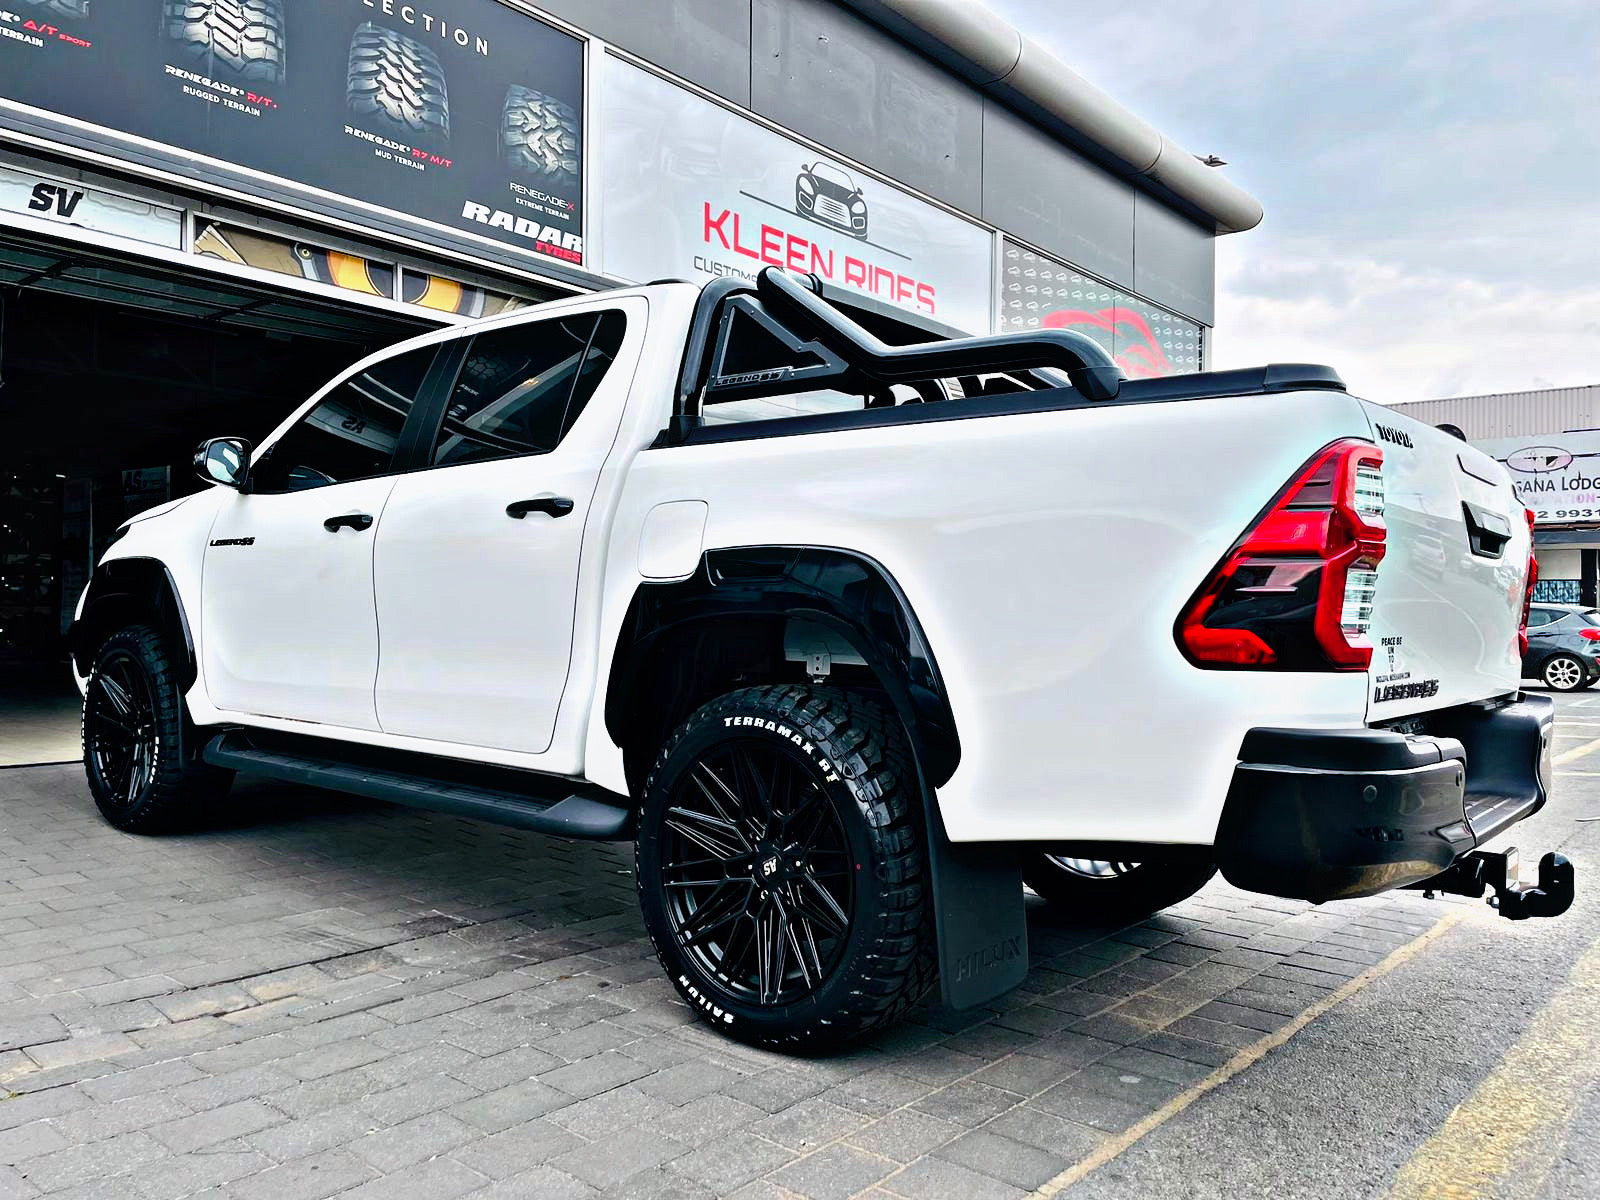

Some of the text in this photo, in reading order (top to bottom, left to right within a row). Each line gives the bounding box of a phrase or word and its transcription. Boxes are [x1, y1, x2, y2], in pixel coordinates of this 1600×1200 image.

[23, 19, 58, 36] A/T
[59, 33, 92, 48] SPORT
[183, 85, 261, 117] RUGGED TERRAIN
[375, 148, 425, 171] MUD TERRAIN
[429, 155, 453, 168] M/T
[28, 182, 84, 217] SV
[515, 197, 570, 221] EXTREME TERRAIN
[461, 200, 583, 253] RADAR
[704, 201, 834, 280] KLEEN
[535, 240, 583, 265] TYRES
[1381, 636, 1396, 646] PEACE
[723, 716, 840, 783] TERRAMAX RT
[953, 935, 1022, 984] HILUX
